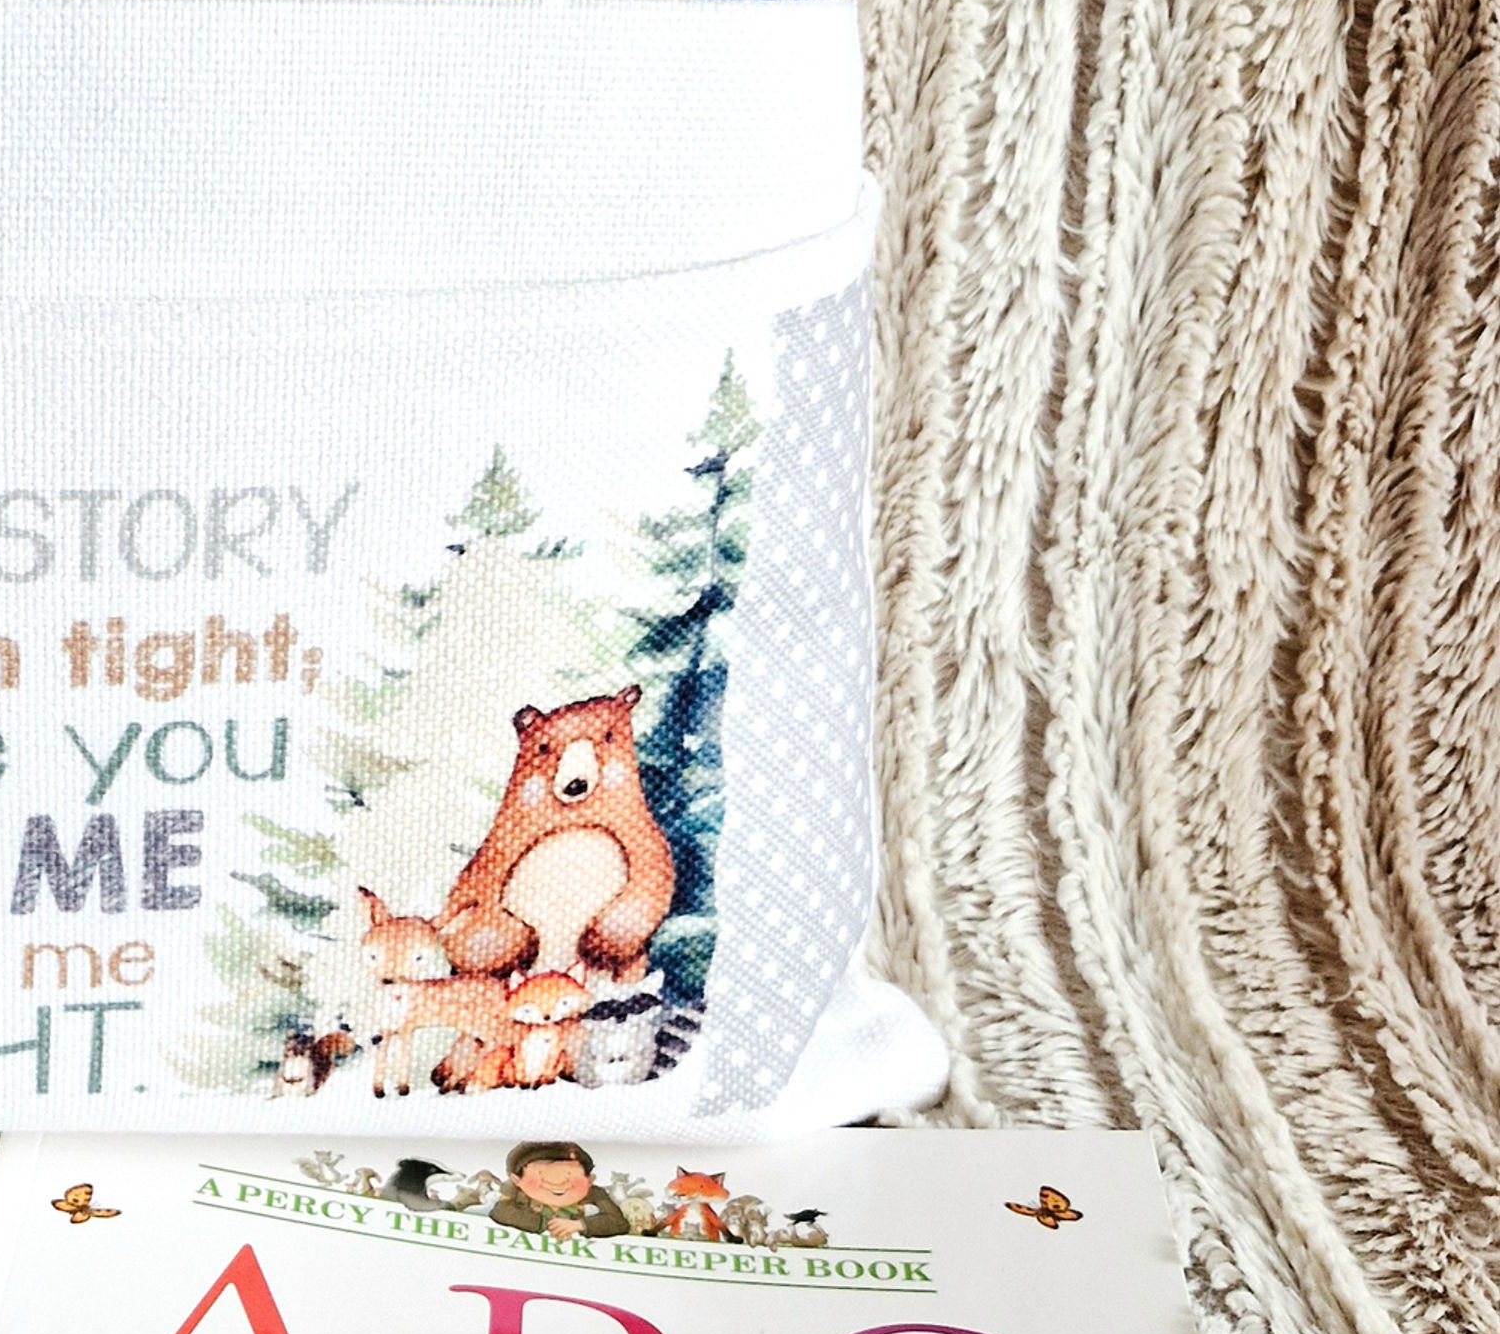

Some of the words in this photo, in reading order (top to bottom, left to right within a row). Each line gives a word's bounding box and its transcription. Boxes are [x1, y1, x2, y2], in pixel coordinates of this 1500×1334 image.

[63, 716, 289, 805] you
[10, 809, 205, 915] ME
[20, 940, 156, 989] me
[197, 1177, 222, 1198] A
[237, 1184, 370, 1224] PERCY
[385, 1212, 471, 1241] THE
[483, 1226, 598, 1260] PARK
[611, 1243, 796, 1277] KEEPER
[803, 1257, 933, 1284] BOOK
